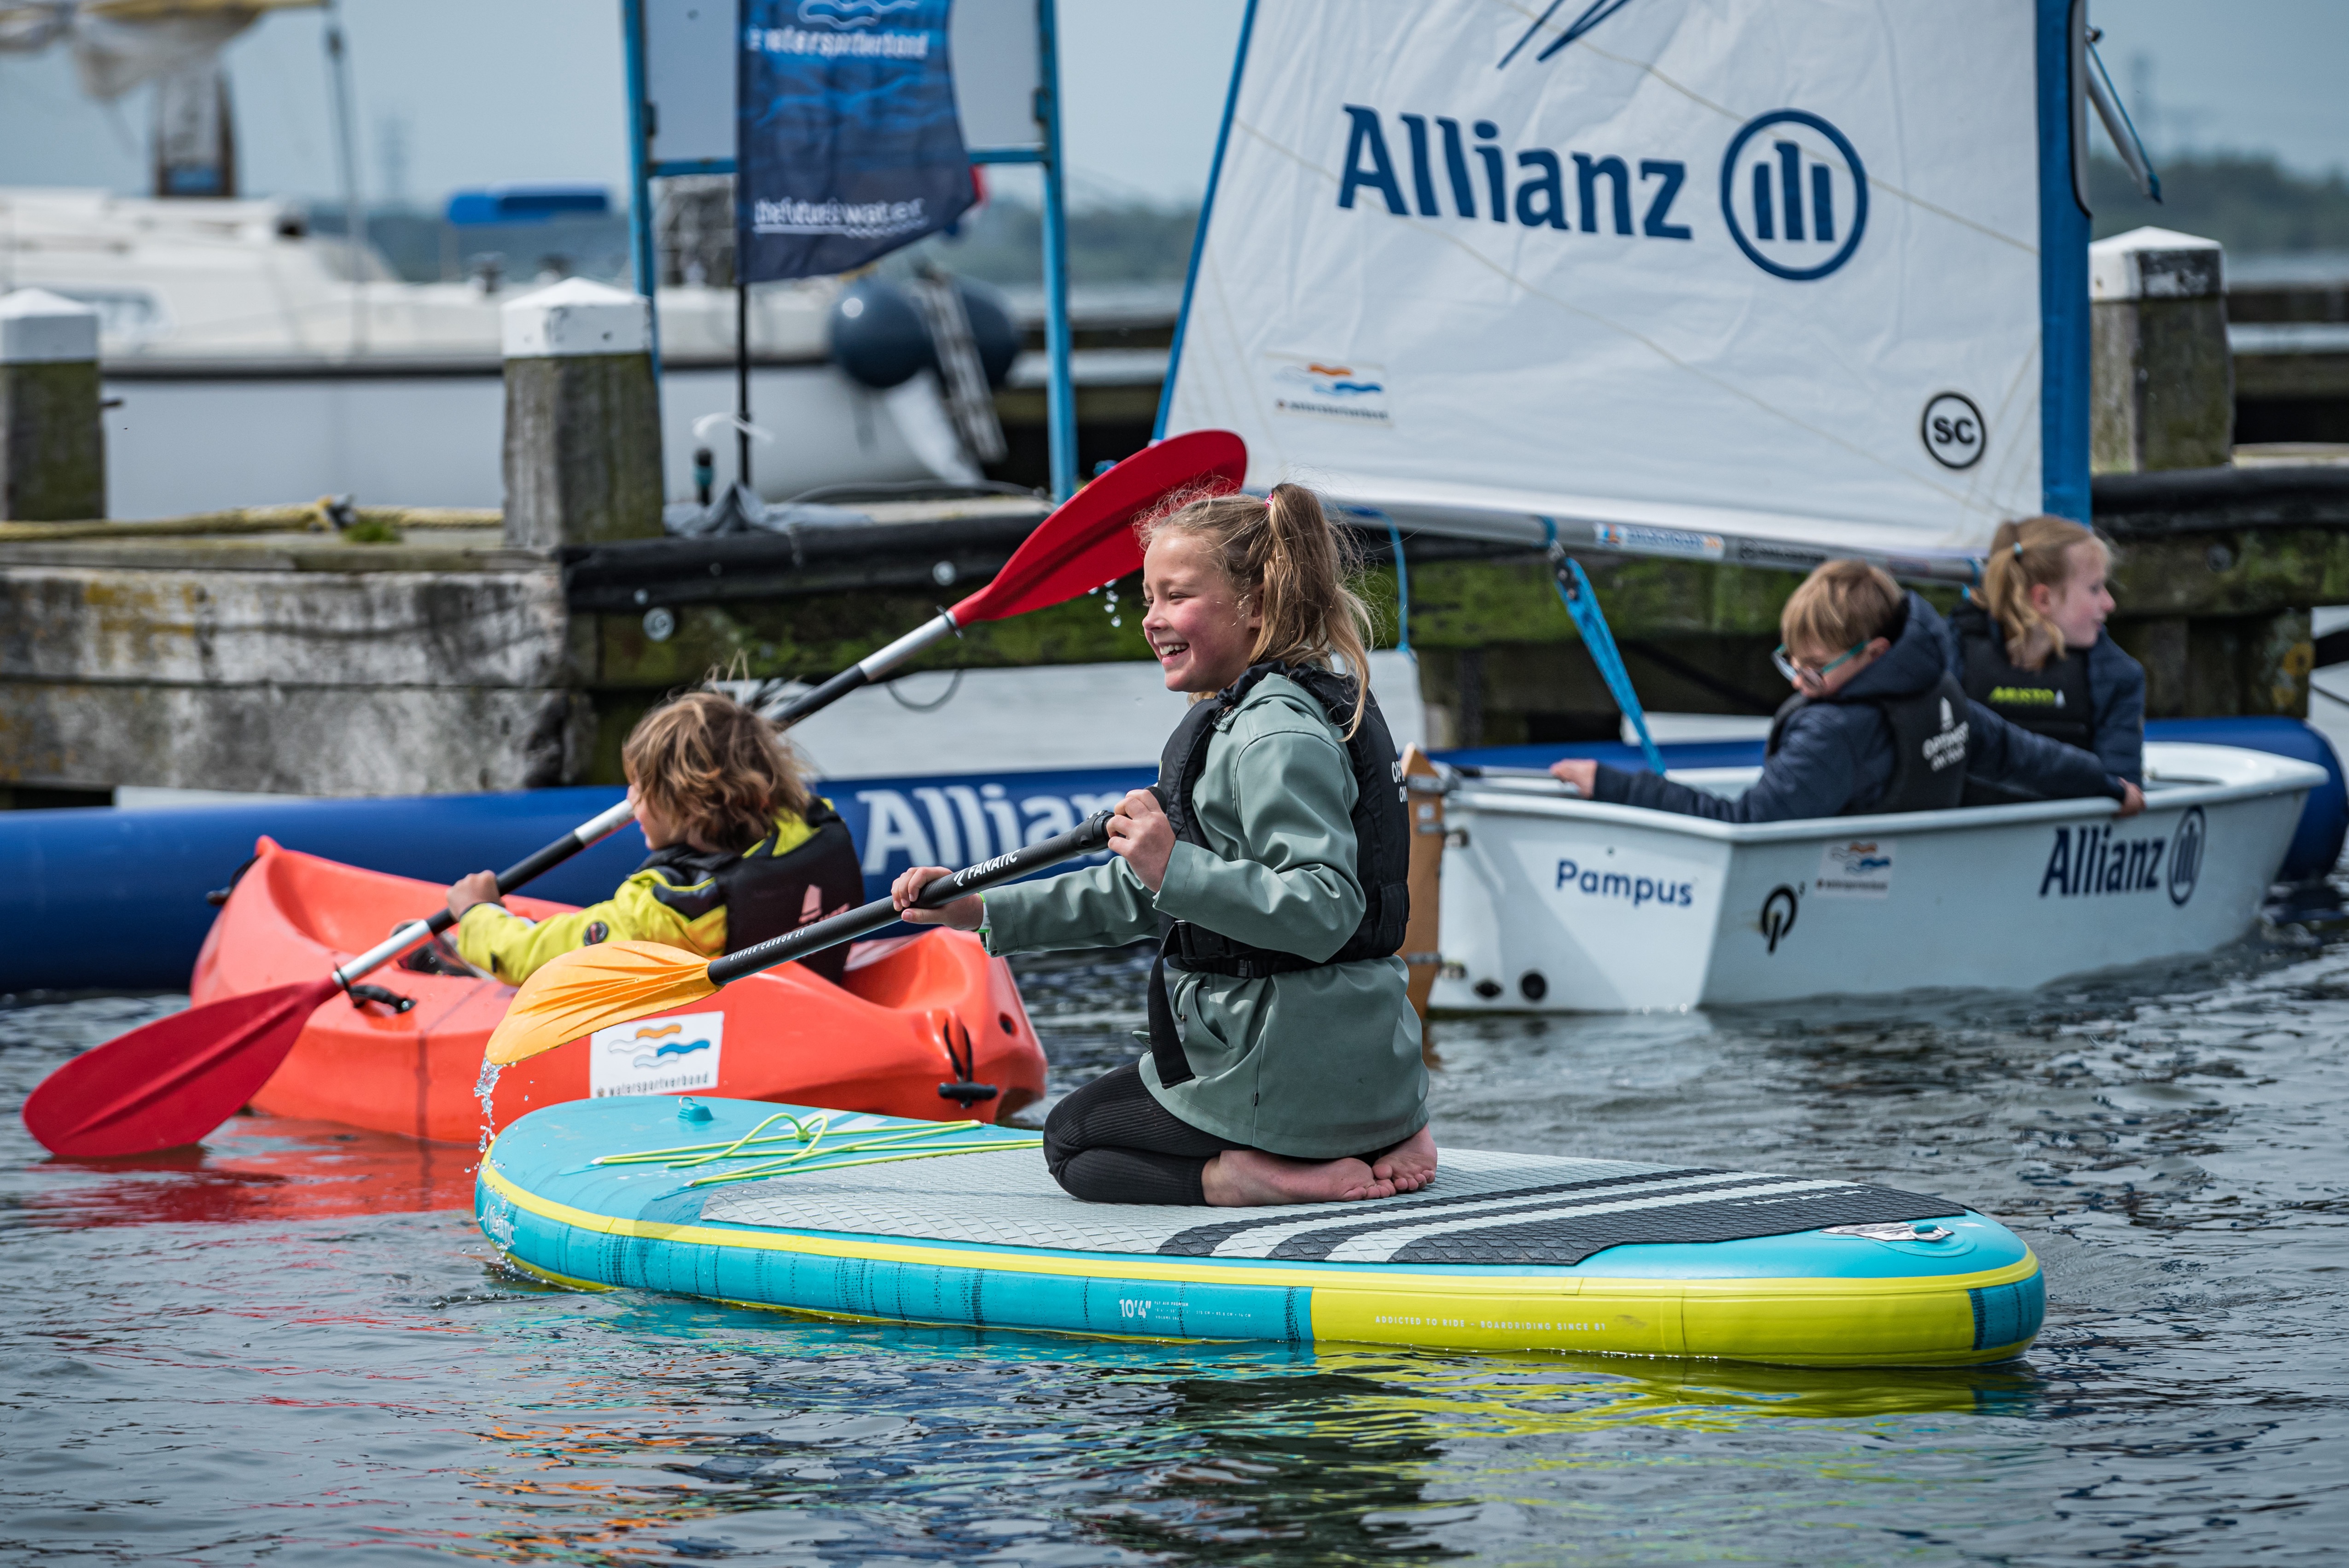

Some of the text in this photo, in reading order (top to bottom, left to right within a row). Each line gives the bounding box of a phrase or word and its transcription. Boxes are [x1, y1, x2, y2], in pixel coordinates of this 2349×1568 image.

[1337, 103, 1694, 240] Allianz
[1933, 415, 1975, 444] SC
[968, 849, 1021, 879] FANATIC
[2039, 823, 2169, 898] Allianz
[1556, 858, 1695, 909] Pampus
[730, 929, 805, 962] RIPPER CARBON 25
[1376, 1315, 1421, 1325] ADDICTED
[1443, 1318, 1465, 1327] RIDE
[1480, 1320, 1551, 1330] BOARDRIDING
